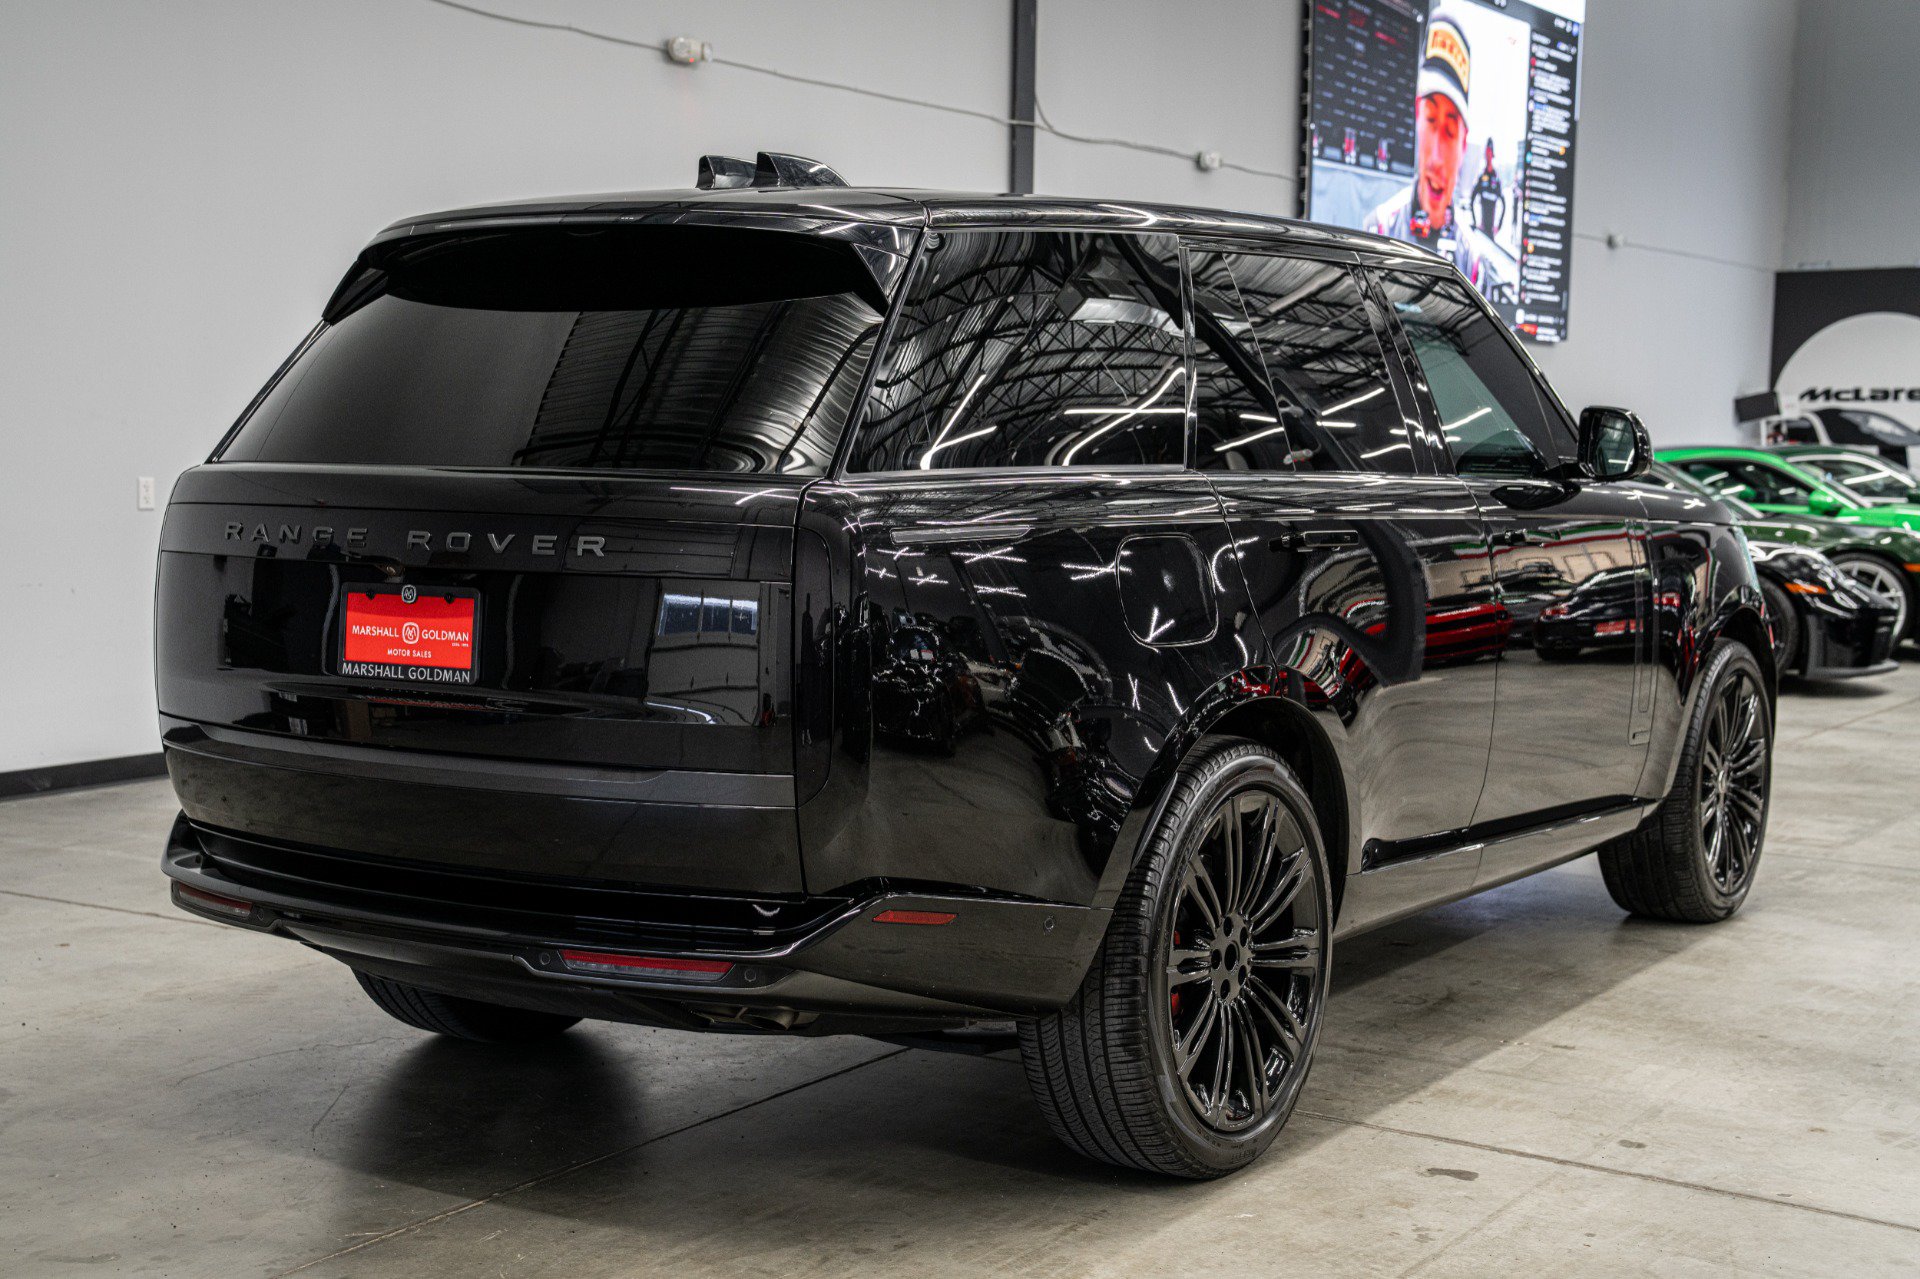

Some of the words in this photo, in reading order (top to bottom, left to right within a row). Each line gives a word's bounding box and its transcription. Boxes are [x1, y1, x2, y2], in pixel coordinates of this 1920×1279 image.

[224, 521, 368, 549] RANGE
[406, 530, 606, 557] ROVER
[352, 624, 400, 638] MARSHALL
[421, 629, 469, 642] GOLDMAN
[387, 648, 411, 657] MOTOR
[412, 649, 432, 659] SALES
[342, 662, 405, 679] MARSHALL
[408, 667, 470, 683] GOLDMAN
